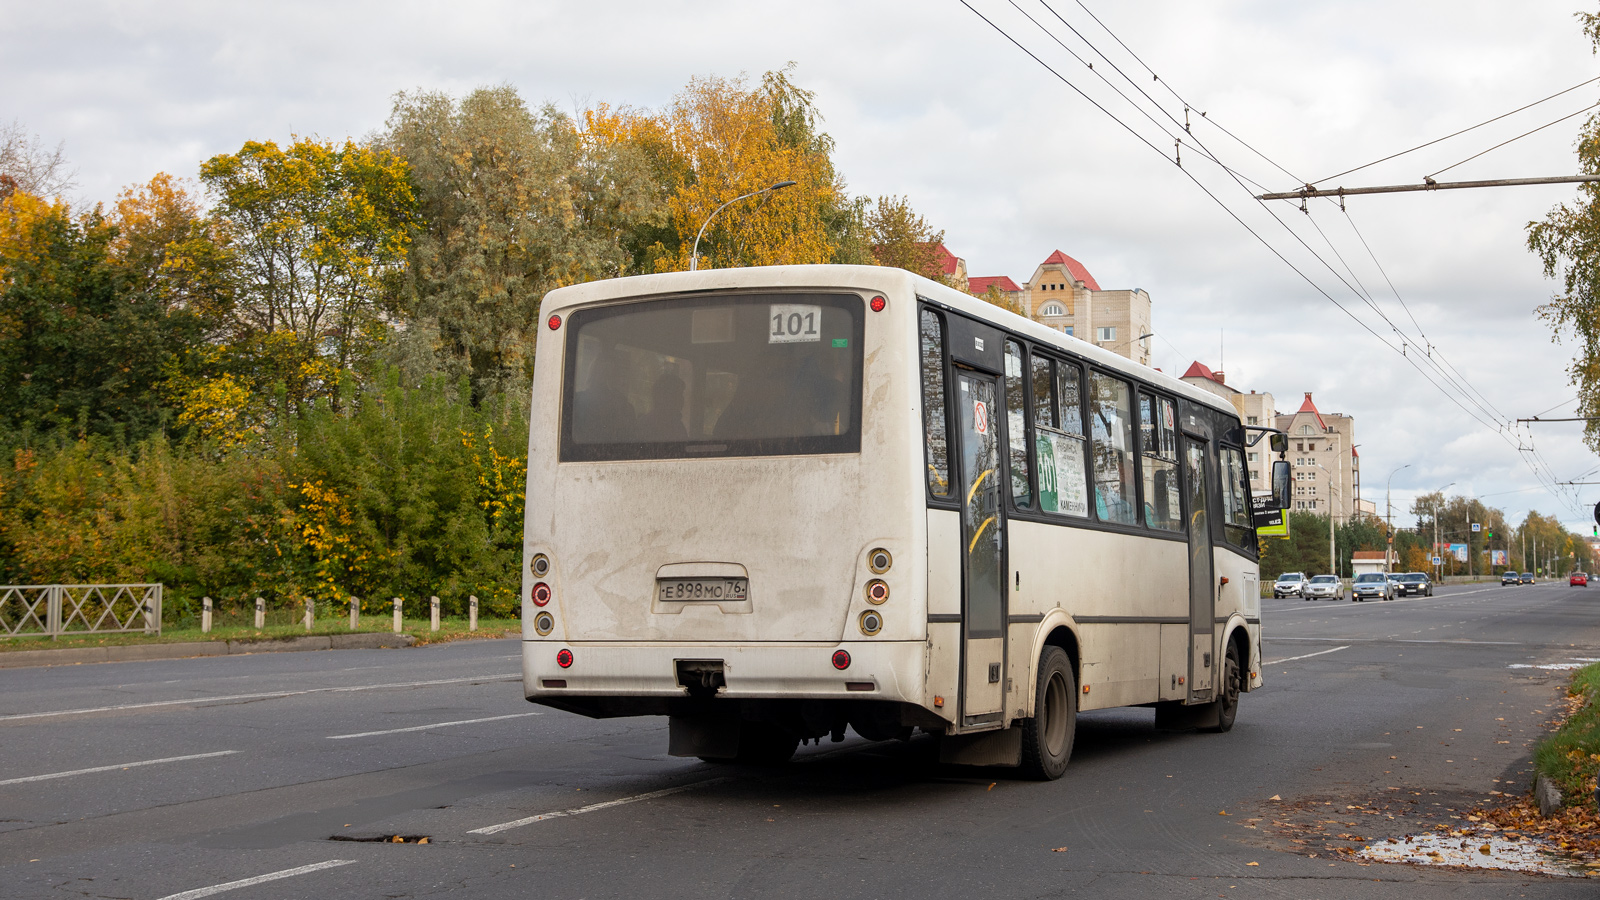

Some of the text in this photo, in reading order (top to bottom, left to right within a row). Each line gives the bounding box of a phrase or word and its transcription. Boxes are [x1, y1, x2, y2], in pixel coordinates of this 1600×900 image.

[772, 312, 817, 336] 101
[1038, 452, 1057, 493] 101
[727, 582, 741, 593] 76
